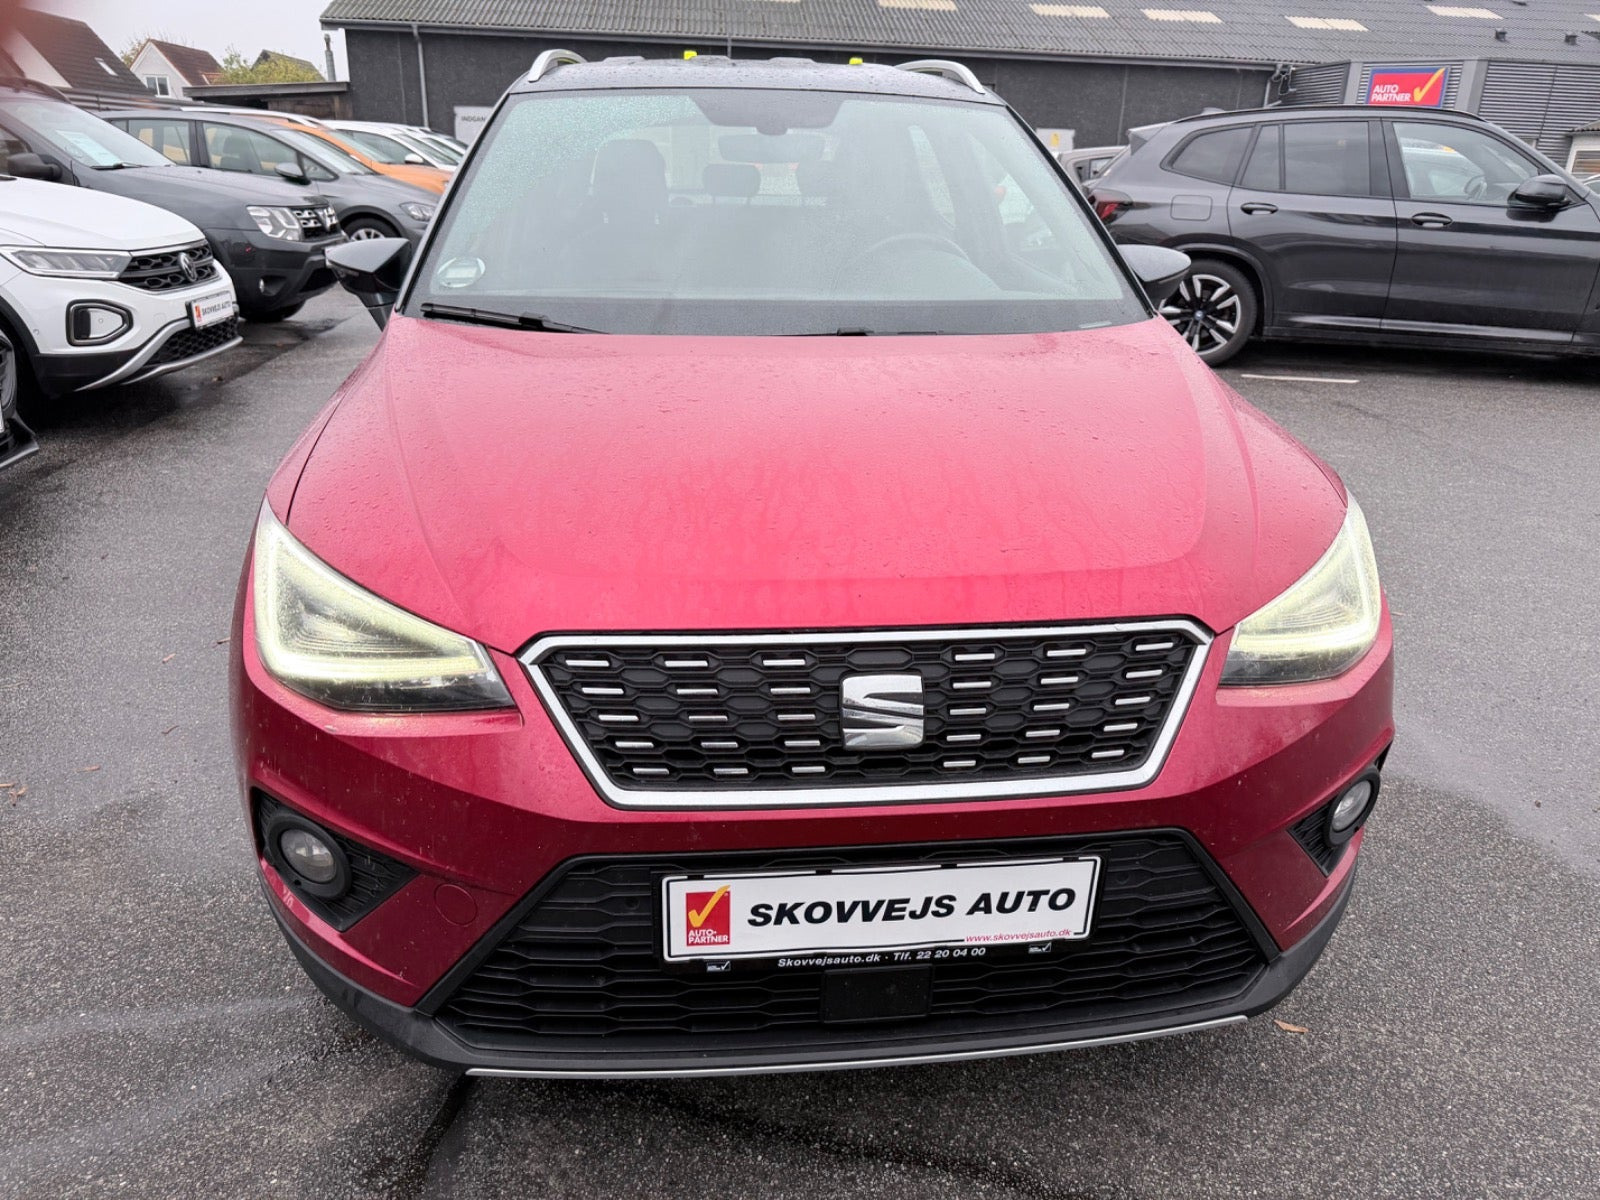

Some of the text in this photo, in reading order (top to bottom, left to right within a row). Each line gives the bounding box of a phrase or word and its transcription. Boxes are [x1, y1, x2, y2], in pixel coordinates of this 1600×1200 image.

[1373, 84, 1399, 93] AUTO
[1371, 93, 1411, 102] PARTNER
[747, 887, 1077, 927] SKOVVEJS AUTO
[688, 928, 717, 937] AUTO-
[965, 928, 1073, 943] www.skovvejsauto.dk
[688, 935, 729, 944] PARTNER
[777, 947, 986, 968] Skovvejsauto.dk Tlf. 22 20 04 00
